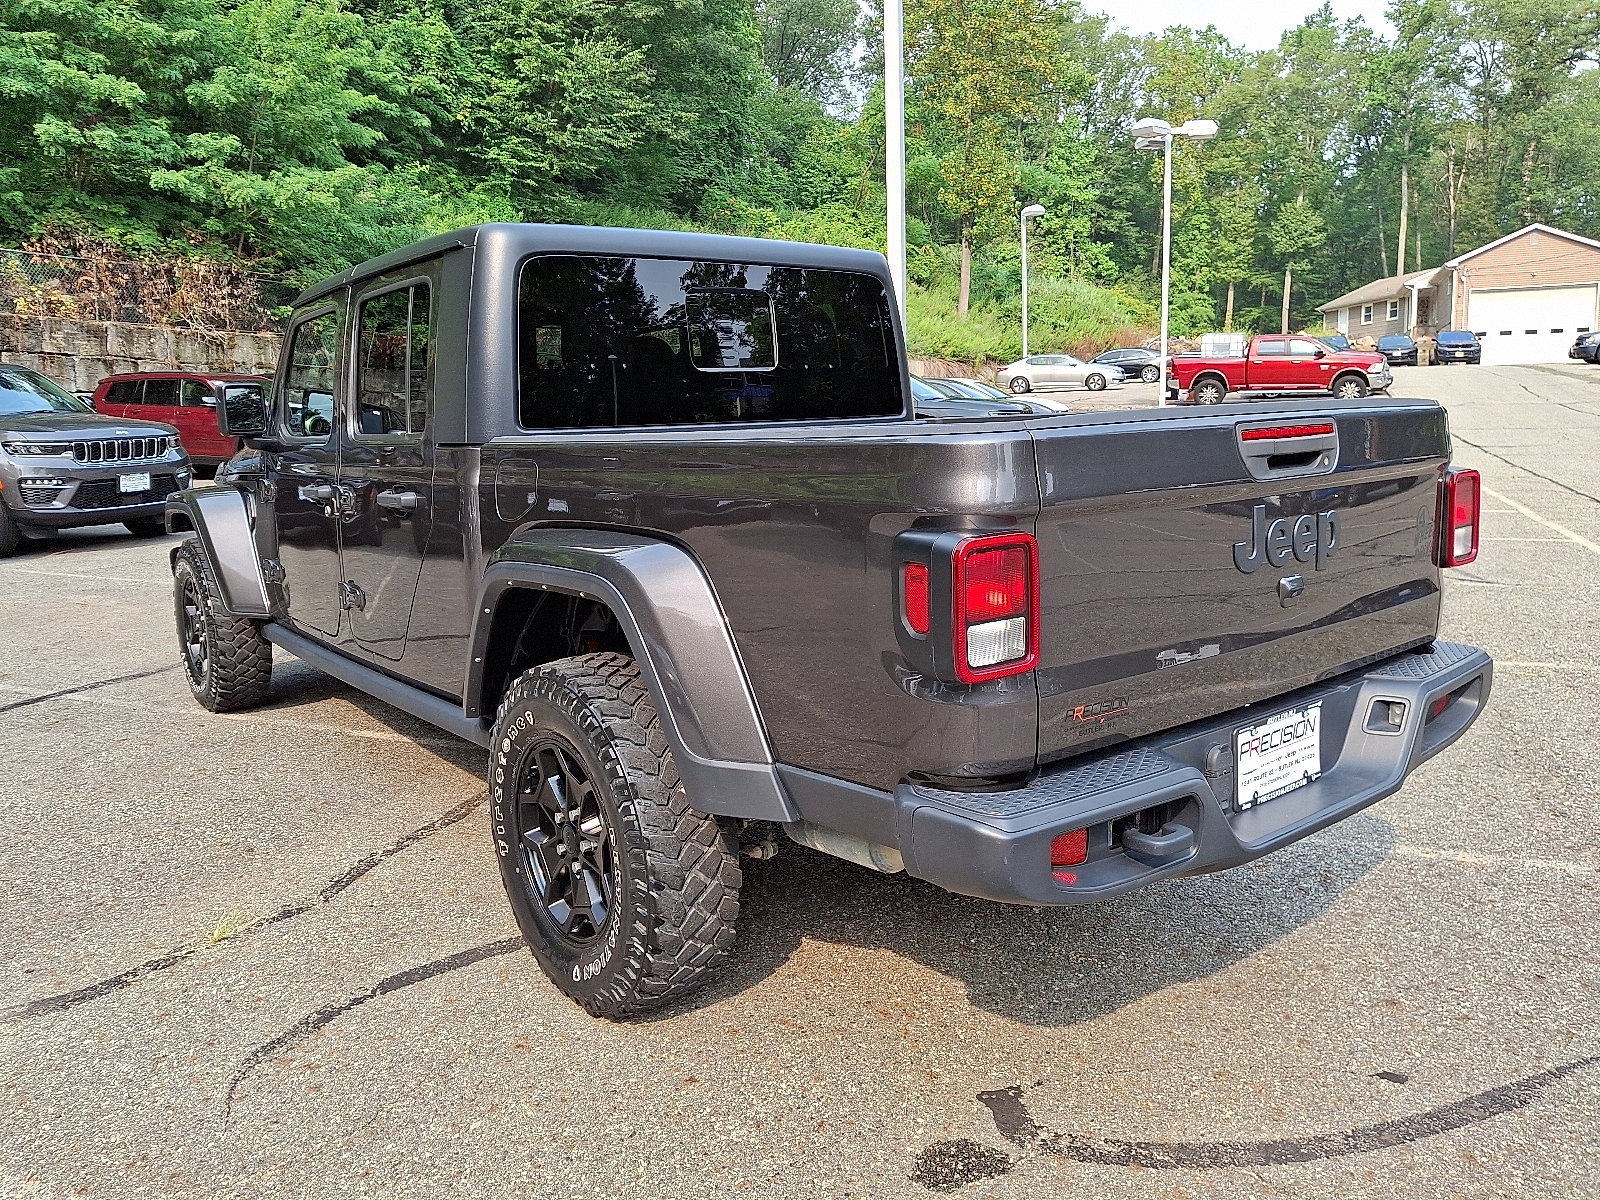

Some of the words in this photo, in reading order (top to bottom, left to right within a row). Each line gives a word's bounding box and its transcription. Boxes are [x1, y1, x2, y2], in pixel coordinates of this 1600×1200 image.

[1233, 504, 1342, 575] Jeep
[1065, 696, 1130, 722] PRECISION
[1240, 715, 1317, 761] PRECISION
